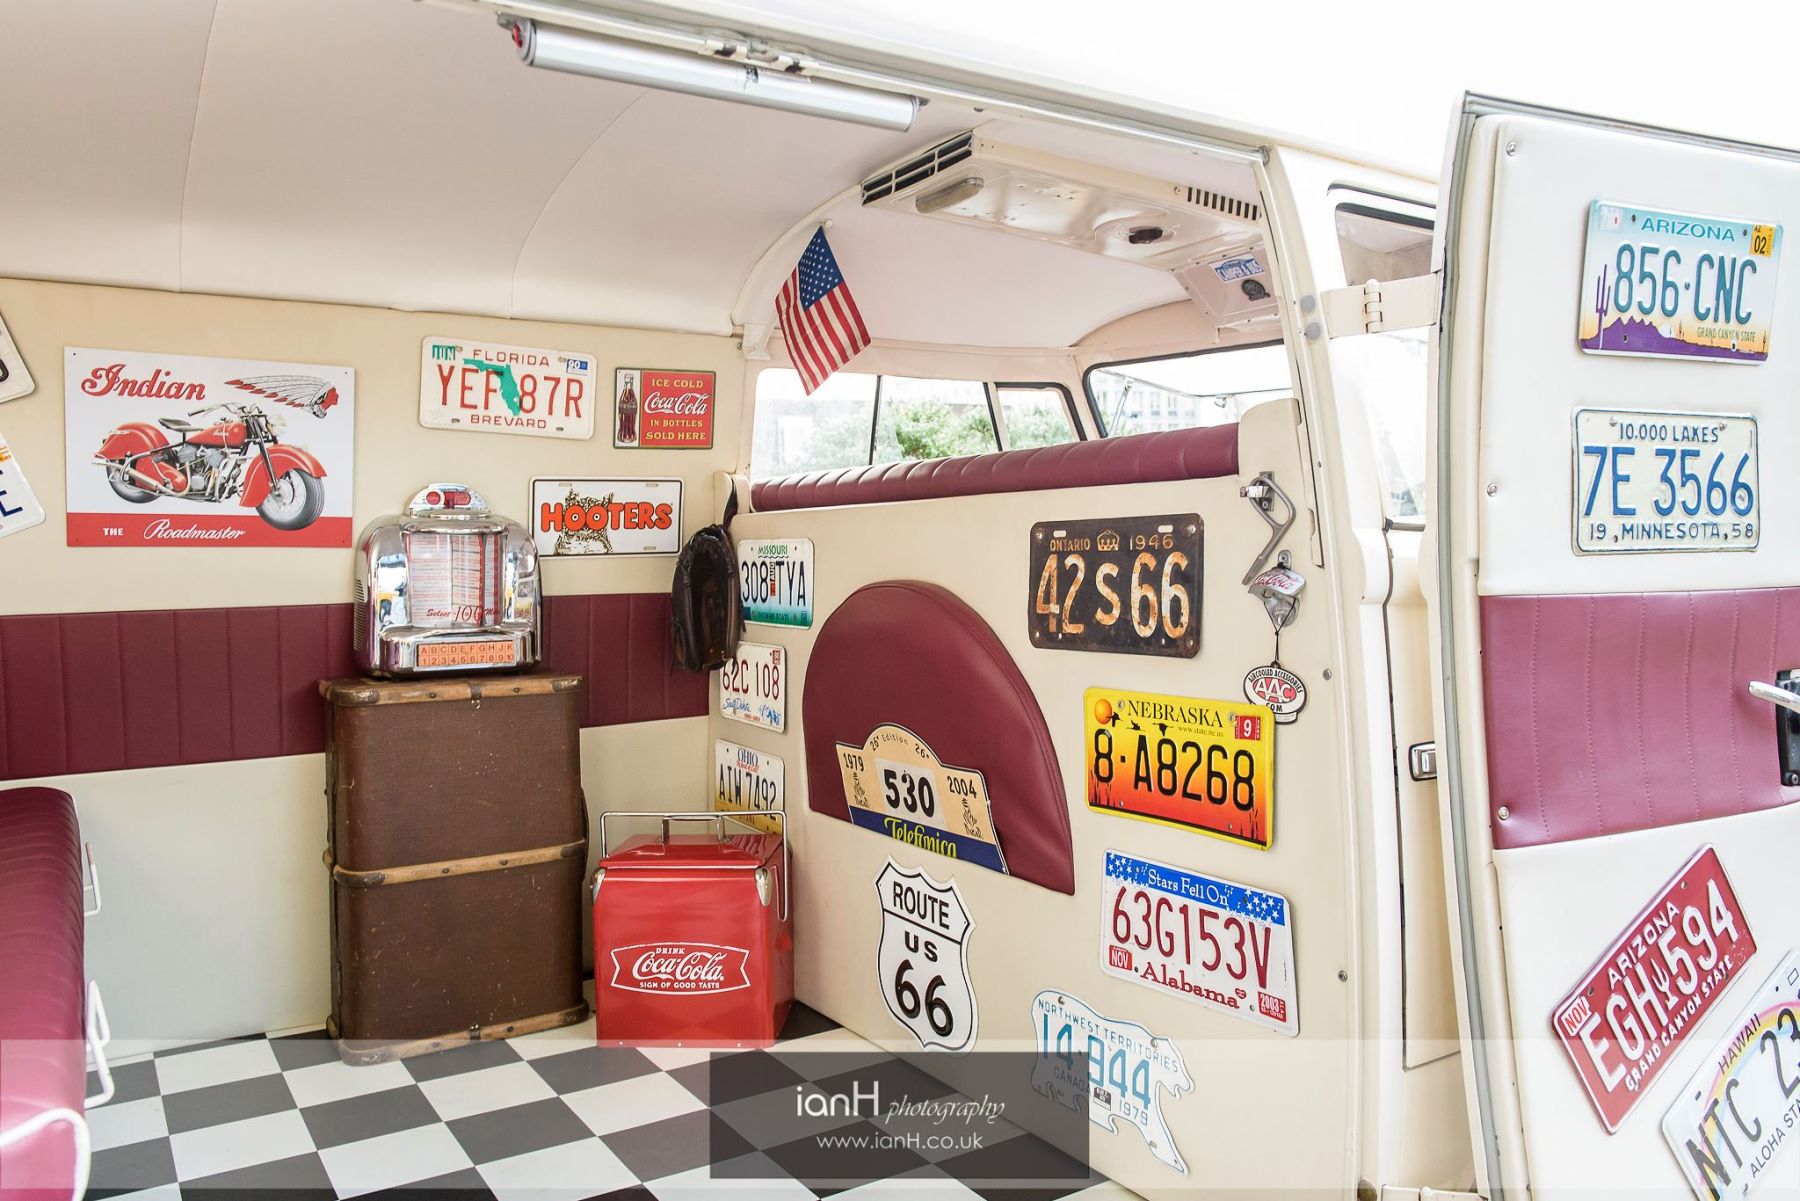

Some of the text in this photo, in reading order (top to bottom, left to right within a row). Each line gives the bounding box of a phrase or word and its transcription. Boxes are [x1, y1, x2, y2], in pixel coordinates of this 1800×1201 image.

[1641, 217, 1735, 242] ARIZONA
[1754, 235, 1767, 254] 02
[1697, 327, 1716, 339] GRAND
[1740, 331, 1756, 343] STATE
[473, 349, 550, 367] FLORIDA
[567, 360, 581, 370] 90
[81, 364, 206, 401] Indian
[519, 374, 584, 418] 87R
[651, 378, 704, 388] ICE COLD
[470, 414, 547, 429] BREVARD
[650, 418, 703, 428] IN BOTTLES
[1672, 426, 1719, 443] LAKES
[645, 431, 706, 440] SOLD HERE
[1583, 445, 1754, 517] 7E 3566
[103, 519, 246, 540] THE Roadmaster
[541, 502, 673, 533] HOOTERS
[1050, 534, 1174, 551] ONTARIO 1946
[1590, 522, 1754, 541] 19 MINNESOTA 58
[758, 545, 788, 556] MISSOURI
[741, 560, 806, 607] 308 TYA
[723, 659, 780, 700] 62C 108
[1254, 678, 1292, 702] AAC
[1128, 700, 1223, 728] NEBRASKA
[1243, 719, 1252, 737] 9
[737, 748, 758, 766] OHIO
[843, 752, 865, 772] 1979
[884, 769, 934, 817] 530
[947, 775, 977, 799] 2004
[1148, 869, 1228, 906] Stars Fell On
[892, 881, 950, 930] ROUTE
[1111, 949, 1128, 969] NOV
[1608, 901, 1679, 990] ARIZONA
[895, 959, 954, 1037] 66
[1140, 962, 1240, 1010] Alabama
[1580, 879, 1738, 1093] EGH 594
[1564, 997, 1591, 1034] NOV
[1625, 954, 1734, 1091] GRAND CANYON STATE
[1038, 999, 1179, 1073] NORTHWEST TERRITORIES
[1717, 1013, 1761, 1075] HAWAII
[1053, 1066, 1091, 1095] CANADA
[1119, 1099, 1148, 1126] 1979
[1685, 1078, 1762, 1201] NTC
[1750, 1127, 1786, 1179] ALOHA
